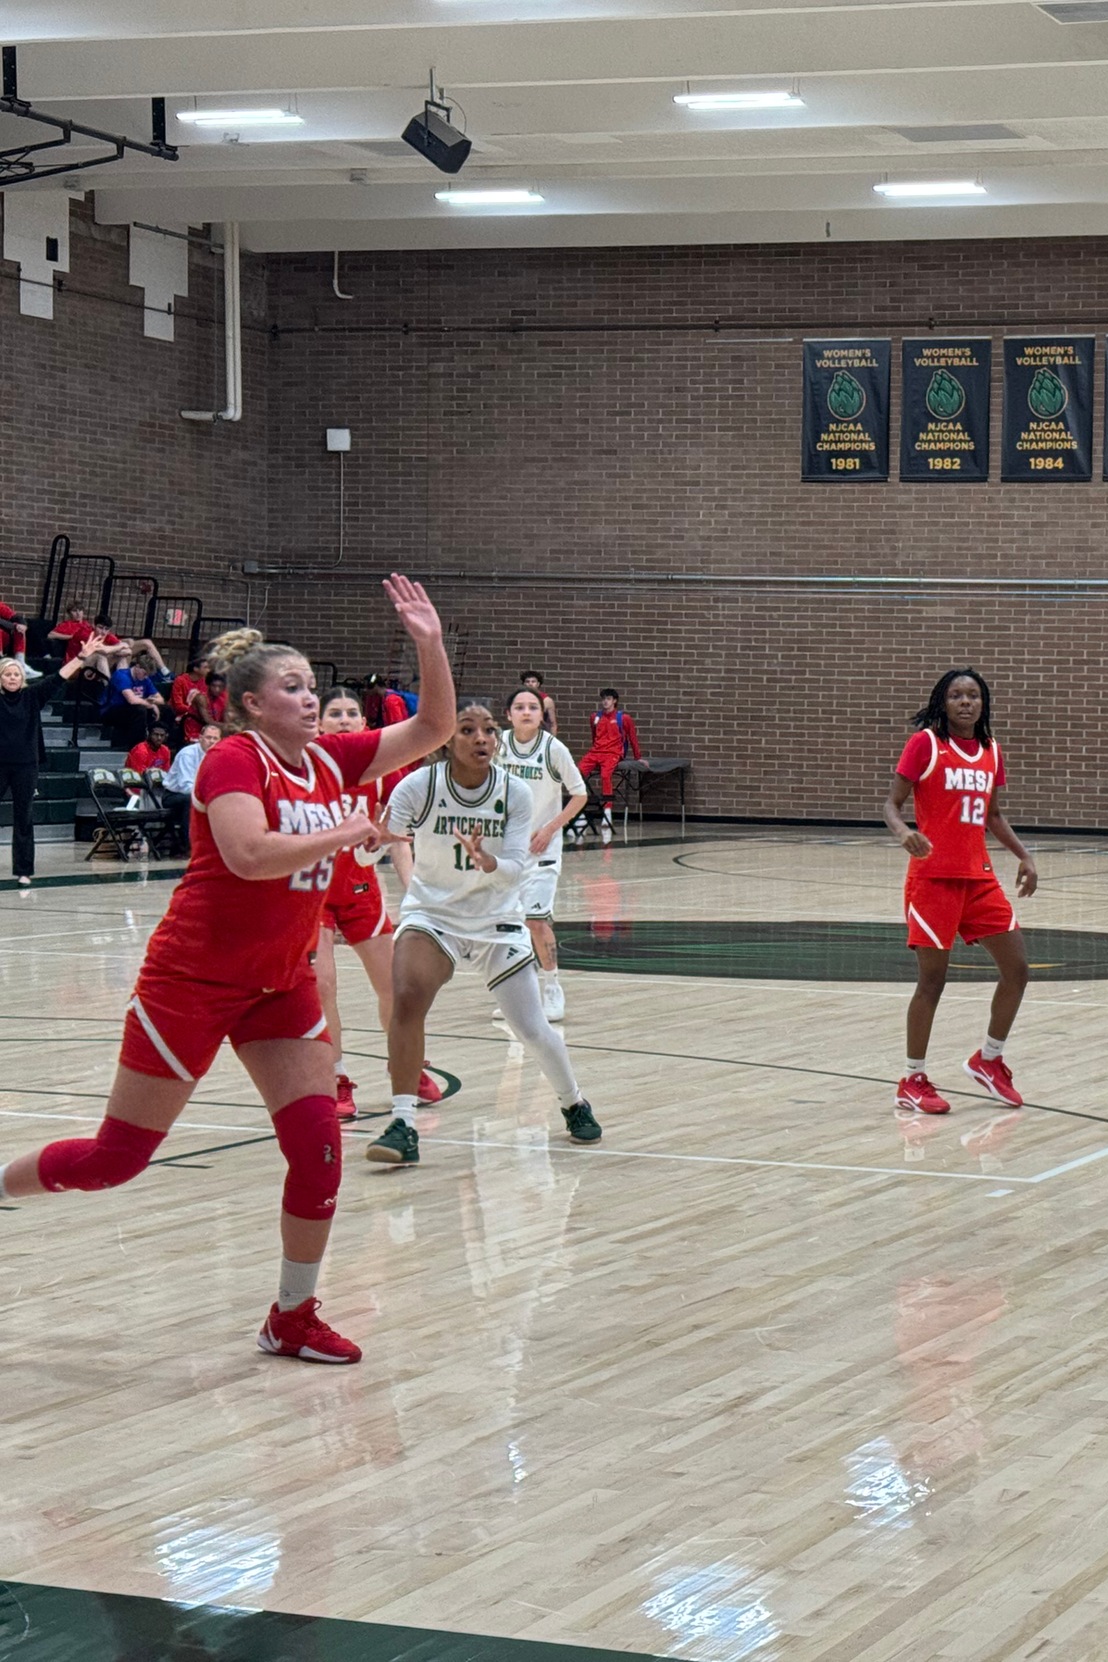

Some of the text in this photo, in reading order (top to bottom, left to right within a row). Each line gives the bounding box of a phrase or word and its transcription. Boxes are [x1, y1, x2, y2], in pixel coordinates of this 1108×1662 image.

[823, 348, 871, 358] WOMEN'S
[922, 347, 971, 357] WOMEN'S
[1024, 346, 1074, 356] WOMEN'S
[815, 358, 879, 368] VOLLEYBALL
[914, 357, 979, 366] VOLLEYBALL
[1016, 356, 1082, 365] VOLLEYBALL
[829, 422, 863, 431] NJCAA
[927, 422, 962, 431] NJCAA
[1029, 421, 1064, 430] NJCAA
[821, 432, 872, 441] NATIONAL
[919, 431, 971, 441] NATIONAL
[1021, 431, 1073, 440] NATIONAL
[816, 441, 875, 451] CHAMPIONS
[914, 441, 975, 451] CHAMPIONS
[1016, 440, 1078, 450] CHAMPIONS
[830, 458, 860, 470] 1981
[927, 458, 961, 470] 1982
[1029, 458, 1064, 469] 1984
[960, 796, 985, 825] 12
